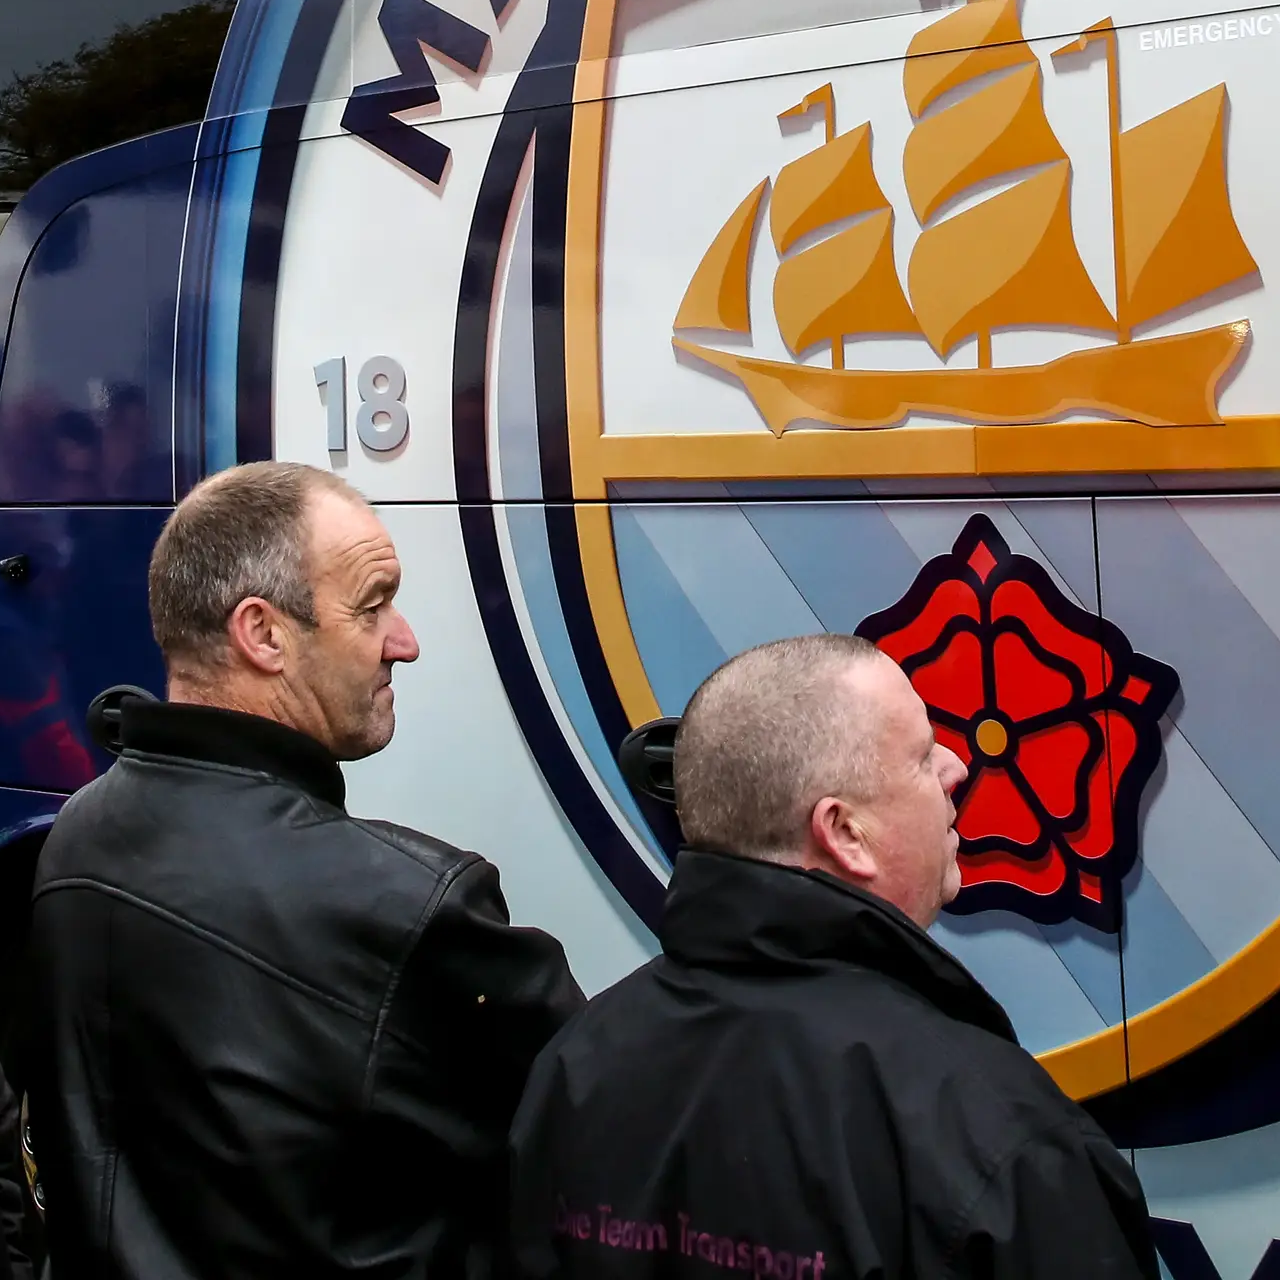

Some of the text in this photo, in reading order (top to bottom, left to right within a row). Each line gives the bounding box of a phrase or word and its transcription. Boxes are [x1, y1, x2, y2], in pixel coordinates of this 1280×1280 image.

[313, 355, 409, 452] 18
[596, 1203, 668, 1251] Team
[677, 1210, 826, 1280] Transport
